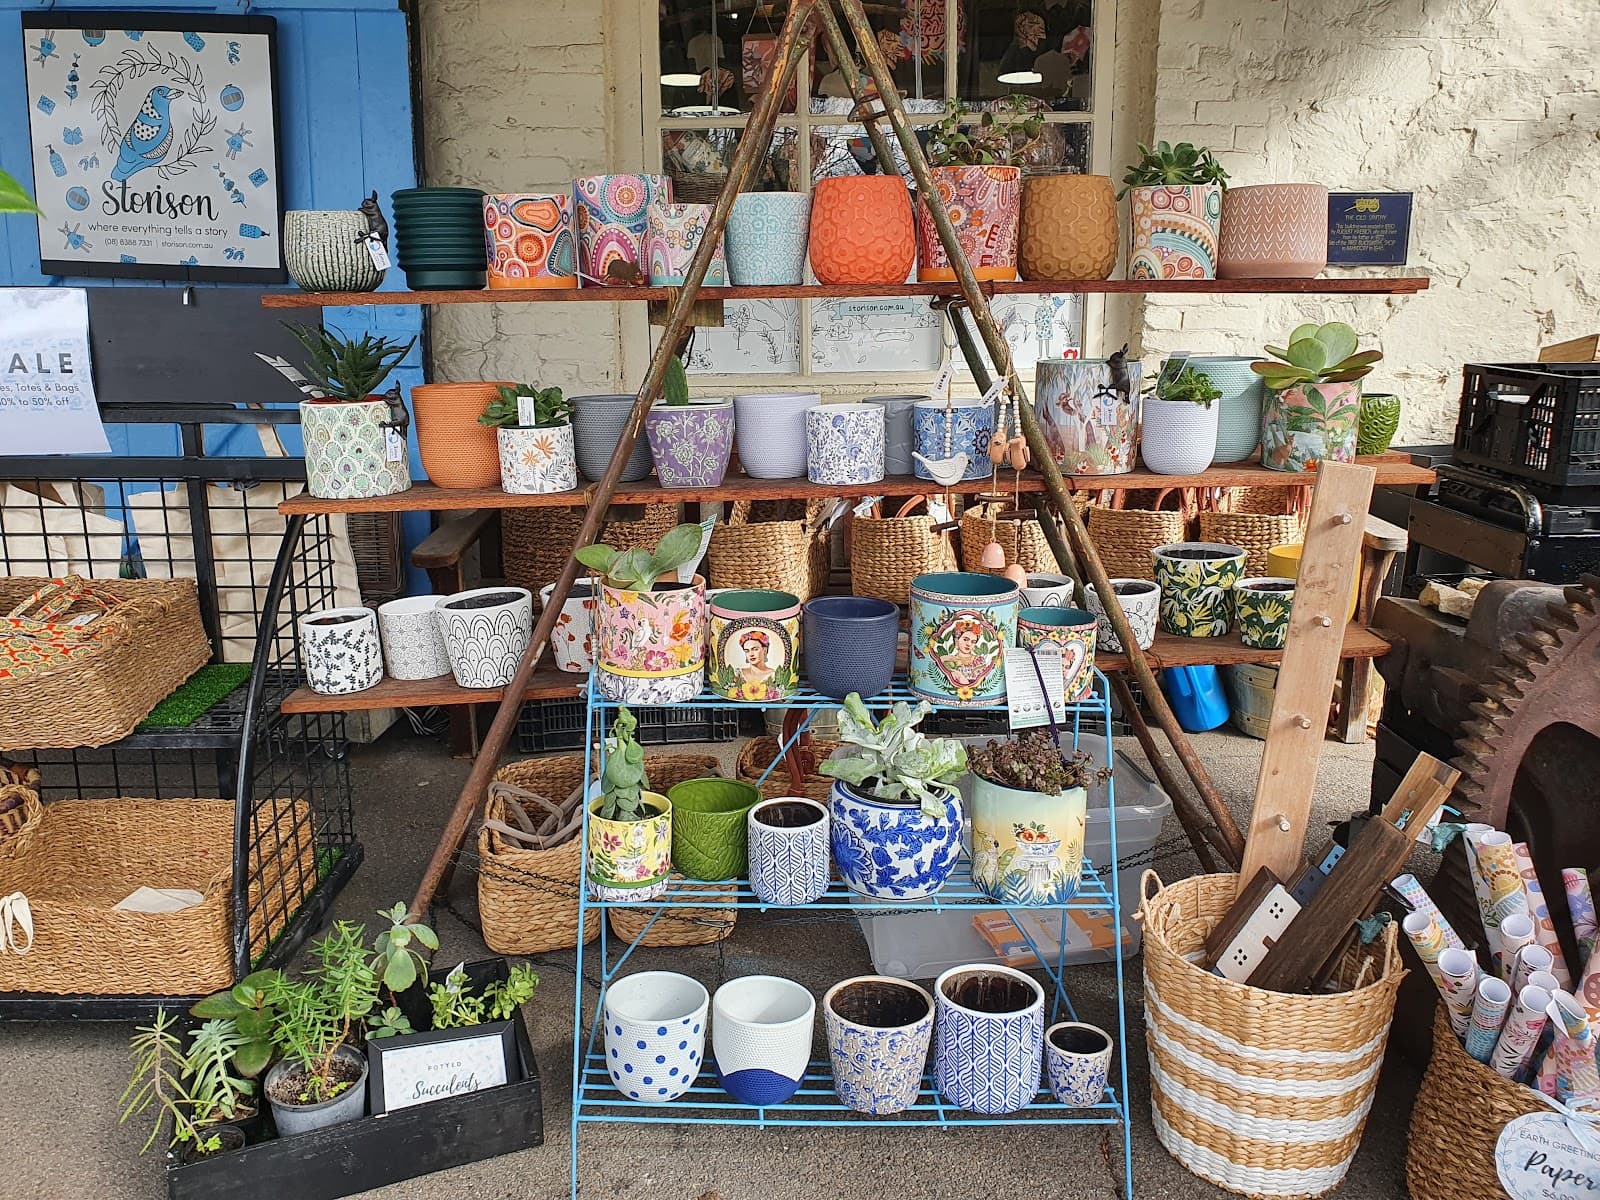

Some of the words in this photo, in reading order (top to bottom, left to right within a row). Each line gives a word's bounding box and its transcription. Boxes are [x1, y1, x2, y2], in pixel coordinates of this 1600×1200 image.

[102, 180, 219, 221] Storison
[87, 221, 119, 232] where
[121, 223, 172, 237] everything
[174, 224, 193, 235] tells
[195, 227, 202, 235] a
[204, 226, 228, 239] story
[104, 238, 118, 247] (08)
[161, 241, 214, 249] storison.com.au
[848, 304, 905, 312] storison.com.au
[8, 352, 73, 374] ALE
[16, 383, 42, 392] Totes
[44, 383, 51, 392] &
[55, 383, 79, 394] Bags
[0, 397, 16, 406] 0%
[18, 397, 29, 406] to
[32, 397, 53, 406] 50%
[56, 397, 69, 406] off
[412, 1072, 481, 1100] Succulents
[1520, 1129, 1550, 1146] EARTH
[1524, 1150, 1597, 1191] Paper
